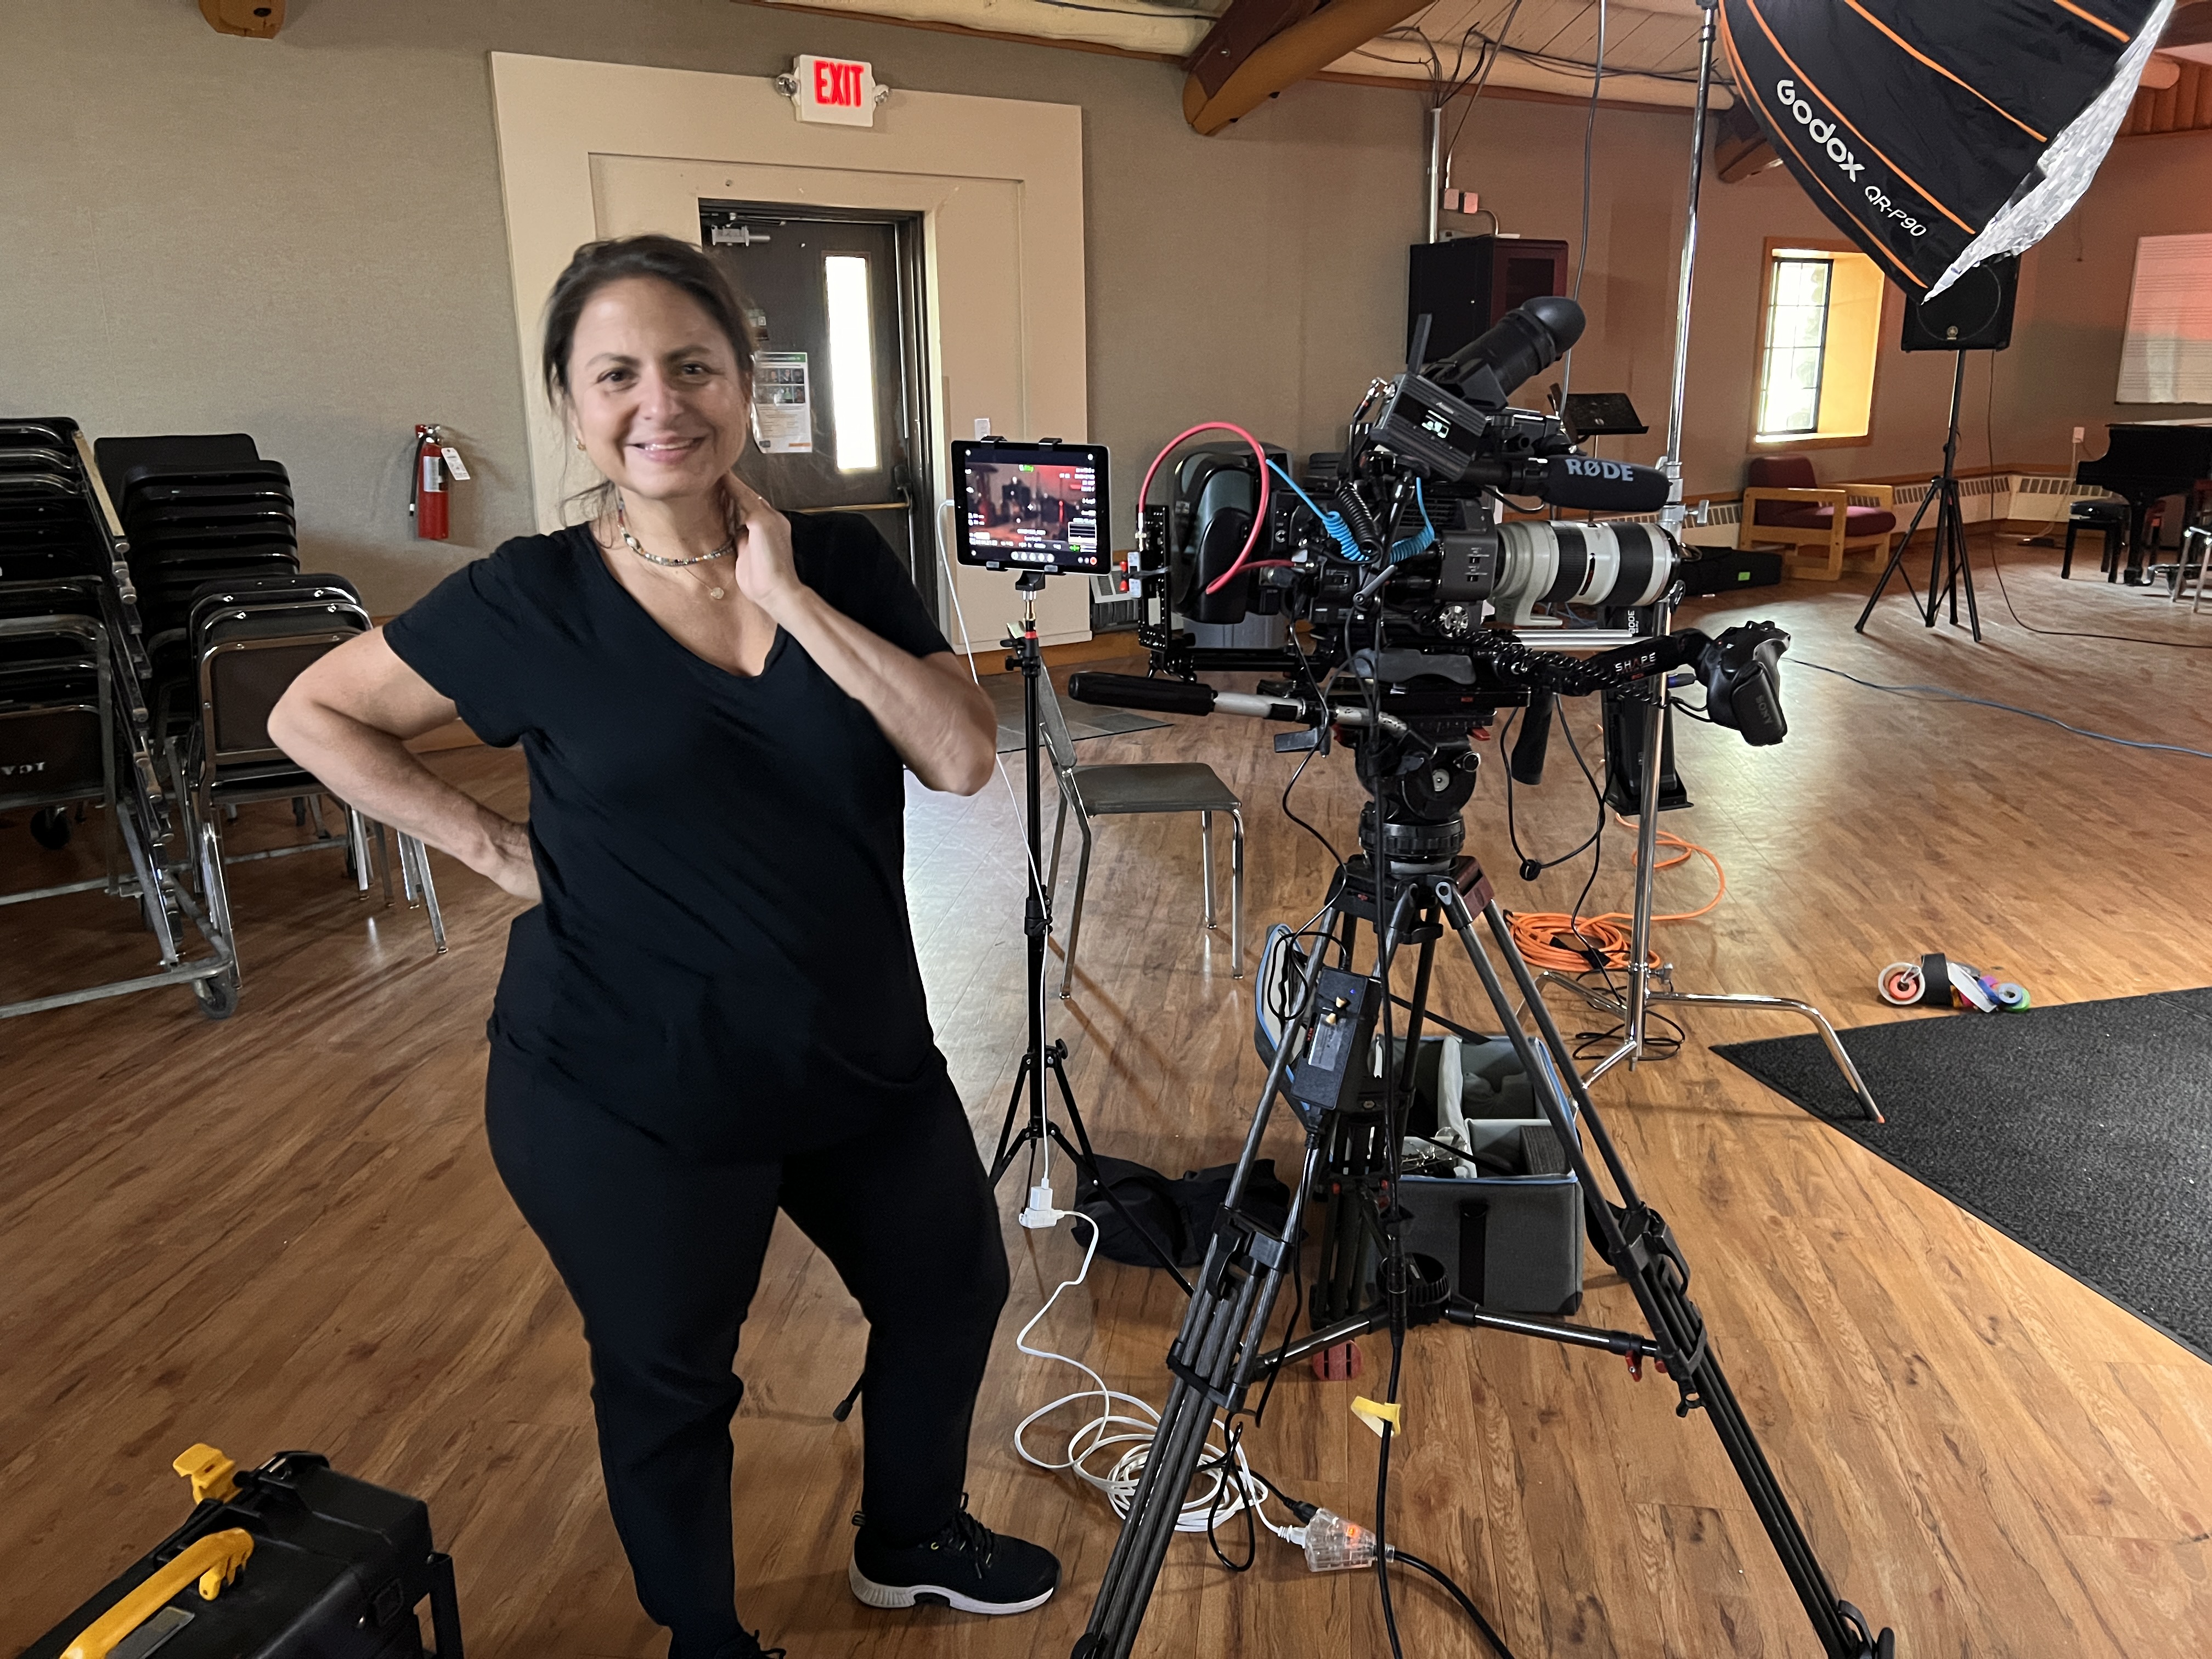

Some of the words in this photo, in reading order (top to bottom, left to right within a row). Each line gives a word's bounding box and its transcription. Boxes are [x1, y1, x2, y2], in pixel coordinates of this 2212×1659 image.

[814, 60, 864, 107] EXIT
[1776, 80, 1865, 182] Godox
[1865, 186, 1927, 236] QR-P90
[1615, 652, 1656, 672] SHAPE
[1756, 694, 1773, 724] SONY
